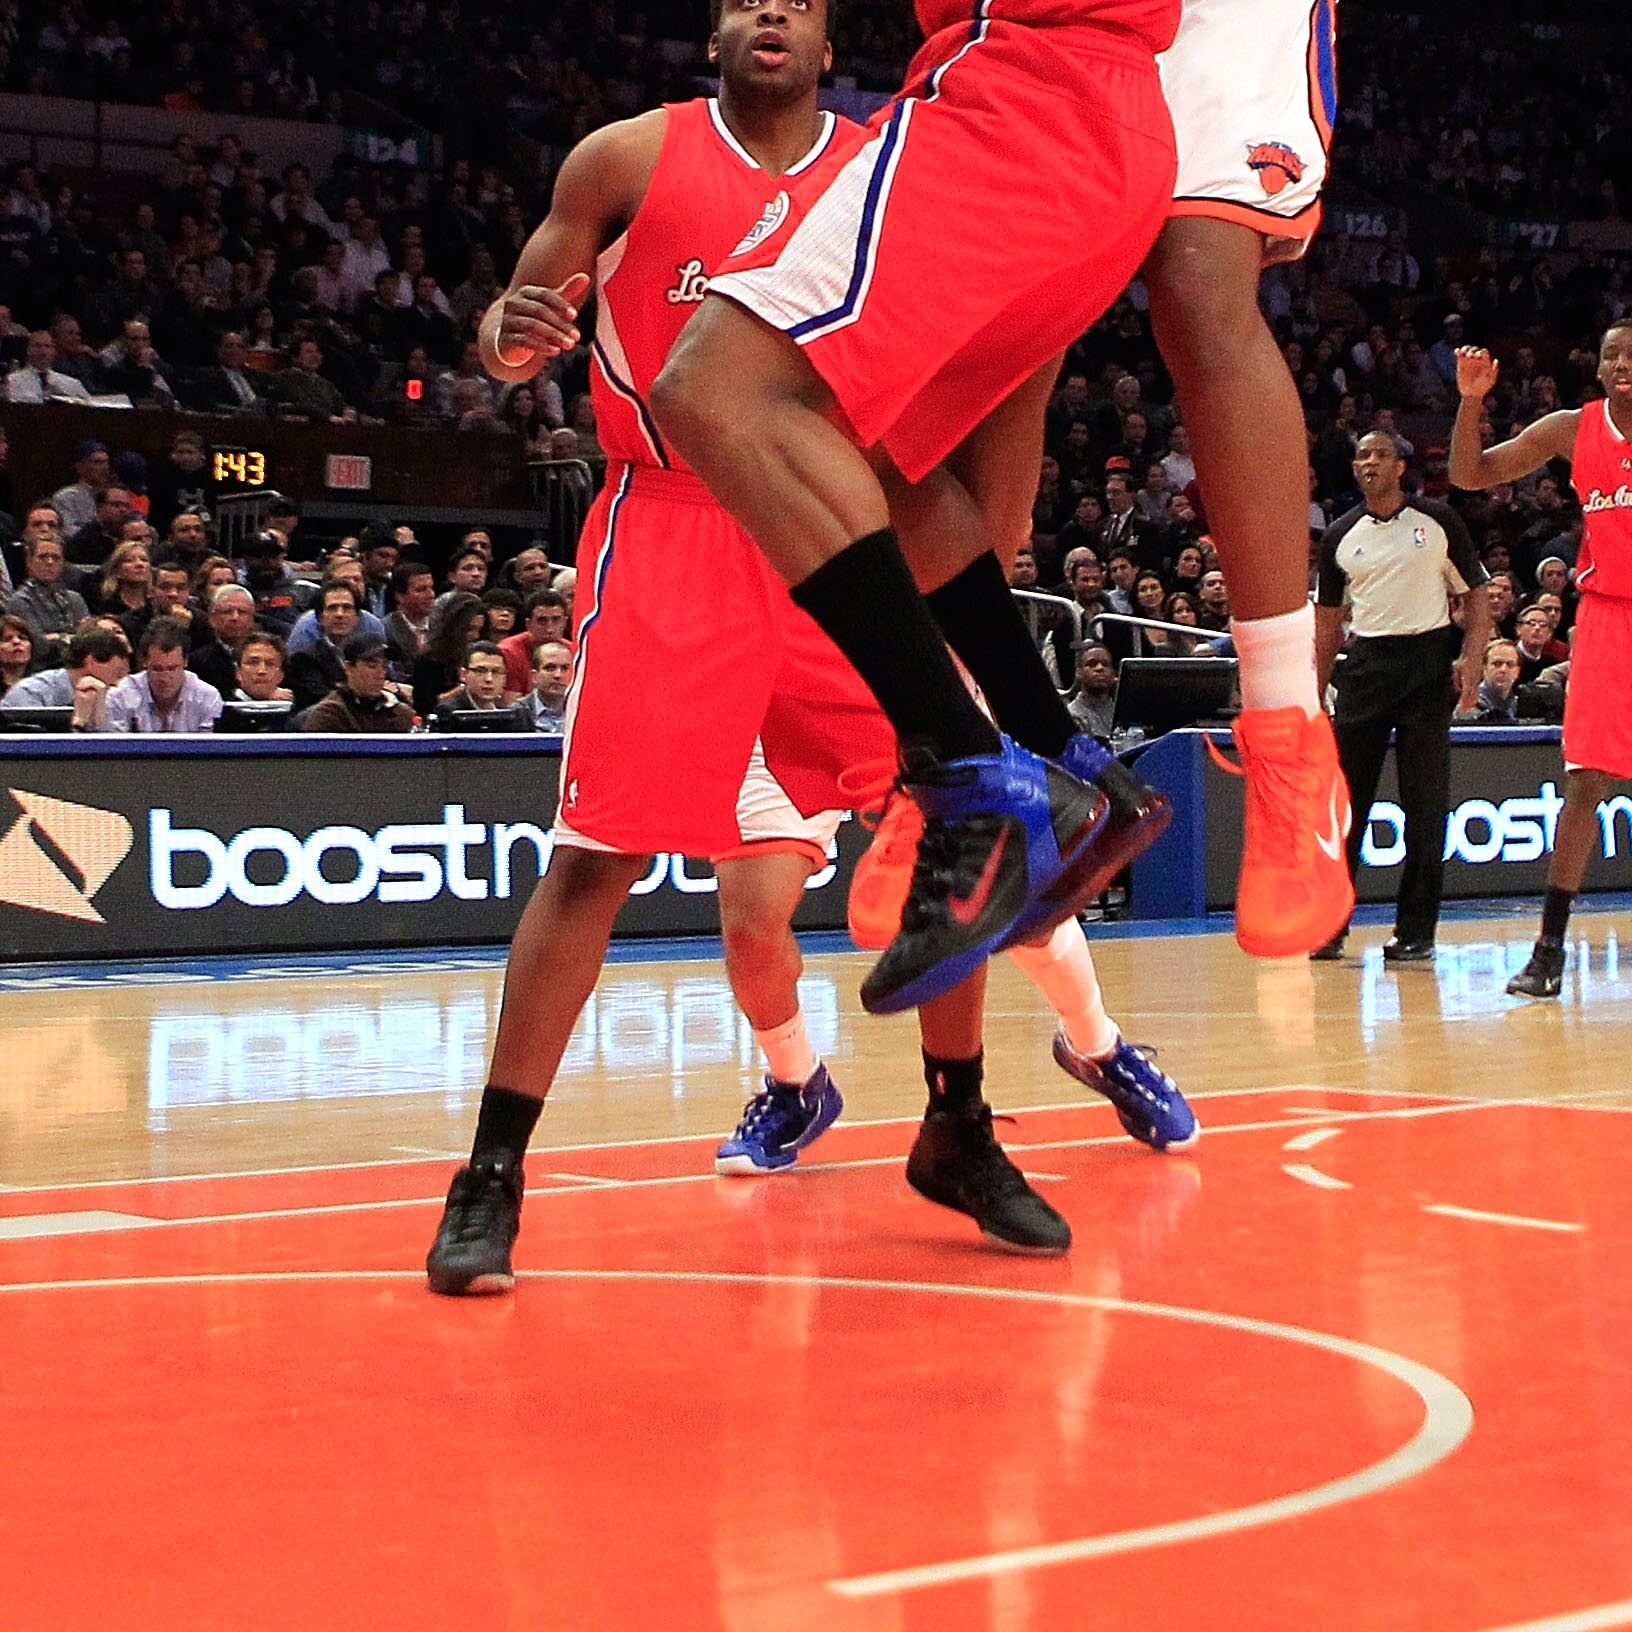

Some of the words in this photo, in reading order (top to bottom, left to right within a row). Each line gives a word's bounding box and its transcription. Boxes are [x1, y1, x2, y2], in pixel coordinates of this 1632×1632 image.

[1344, 212, 1388, 237] 126
[666, 256, 710, 305] Lo
[213, 451, 266, 486] 1:43
[1582, 488, 1615, 513] Los
[149, 804, 489, 909] boost
